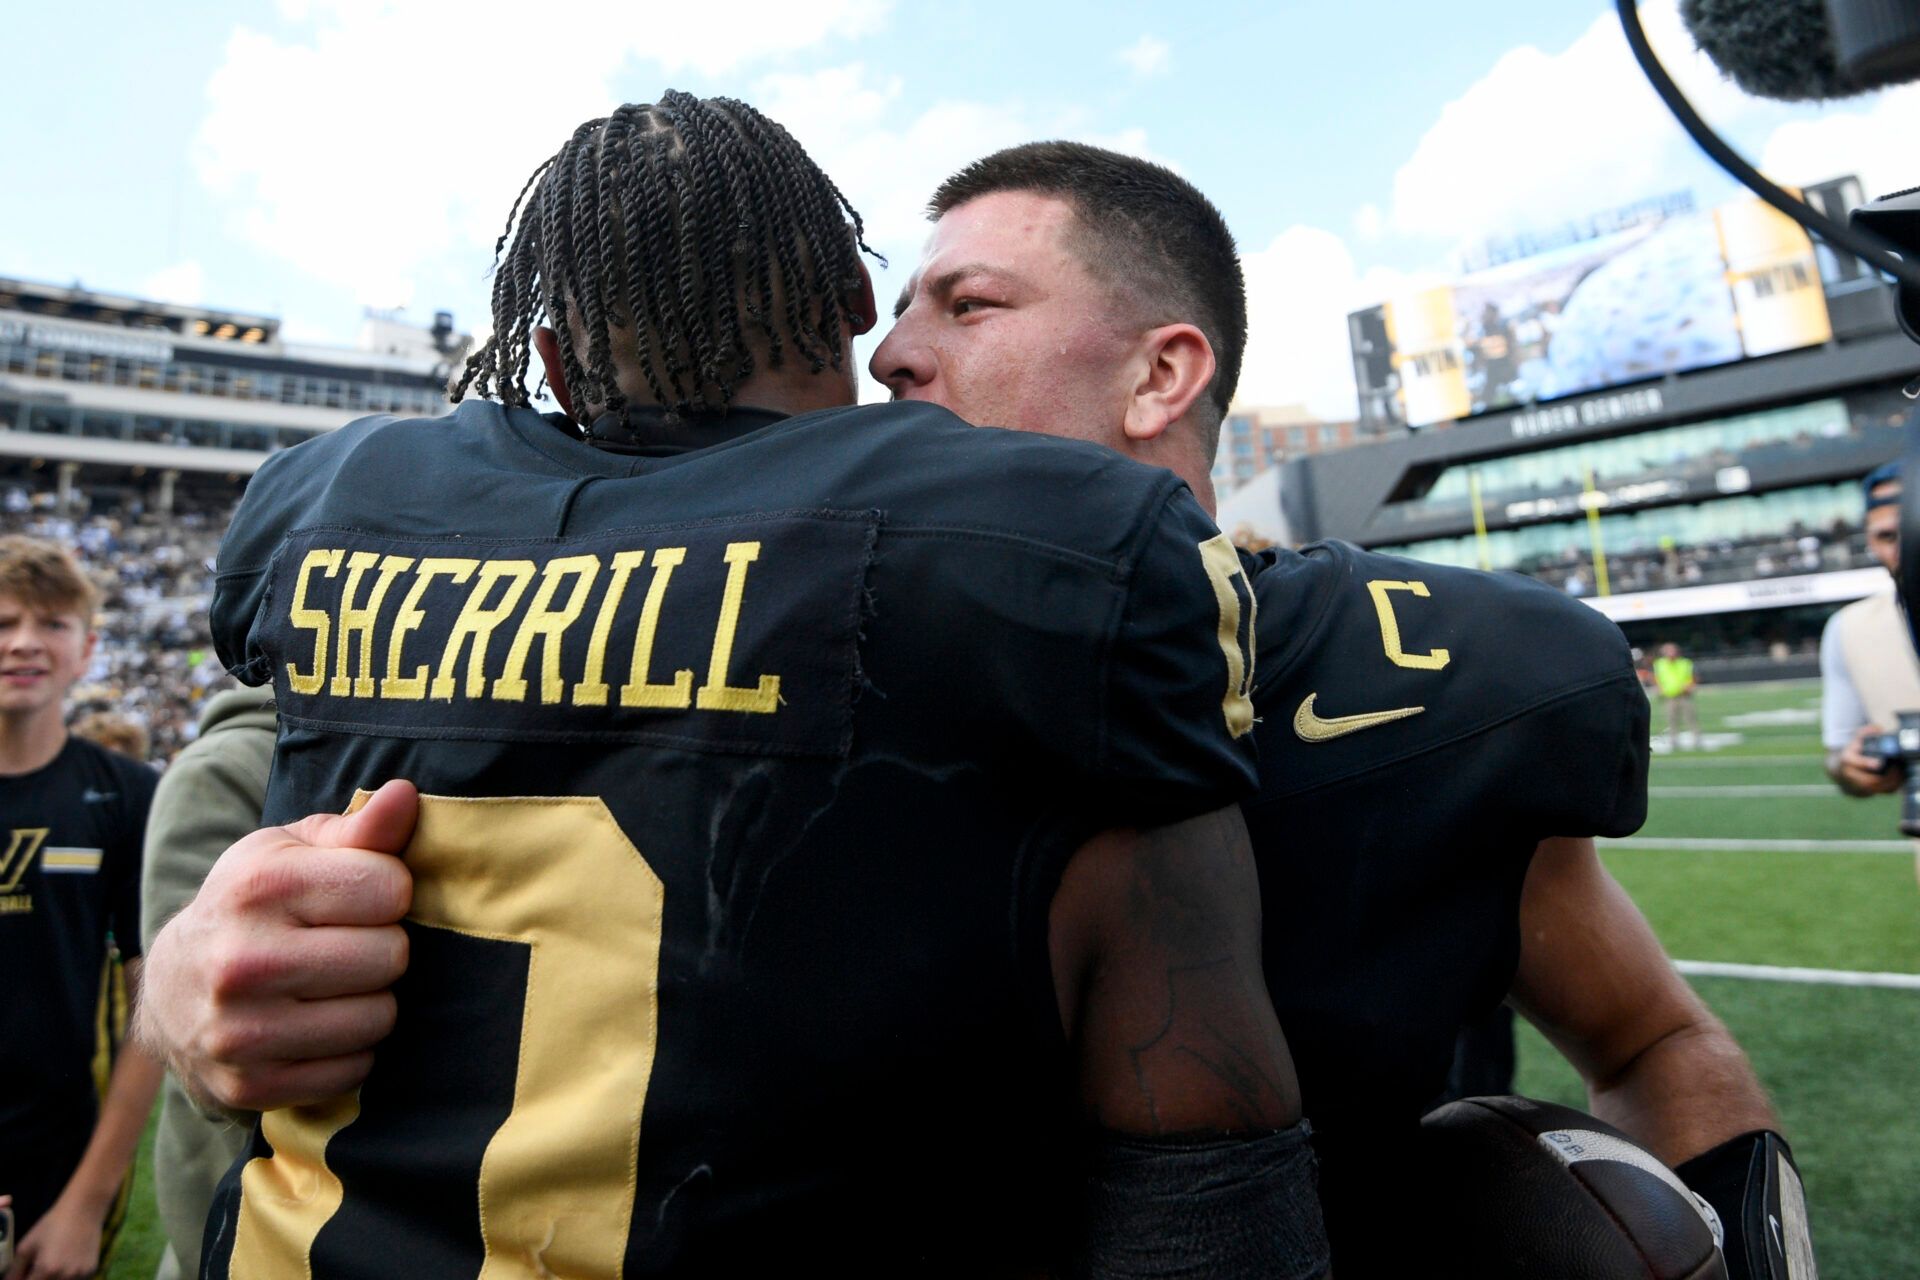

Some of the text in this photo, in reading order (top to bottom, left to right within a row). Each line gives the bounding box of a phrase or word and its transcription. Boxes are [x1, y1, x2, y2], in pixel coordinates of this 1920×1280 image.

[1581, 388, 1663, 426] CENTER
[286, 541, 783, 714] SHERRILL
[1366, 579, 1450, 670] C
